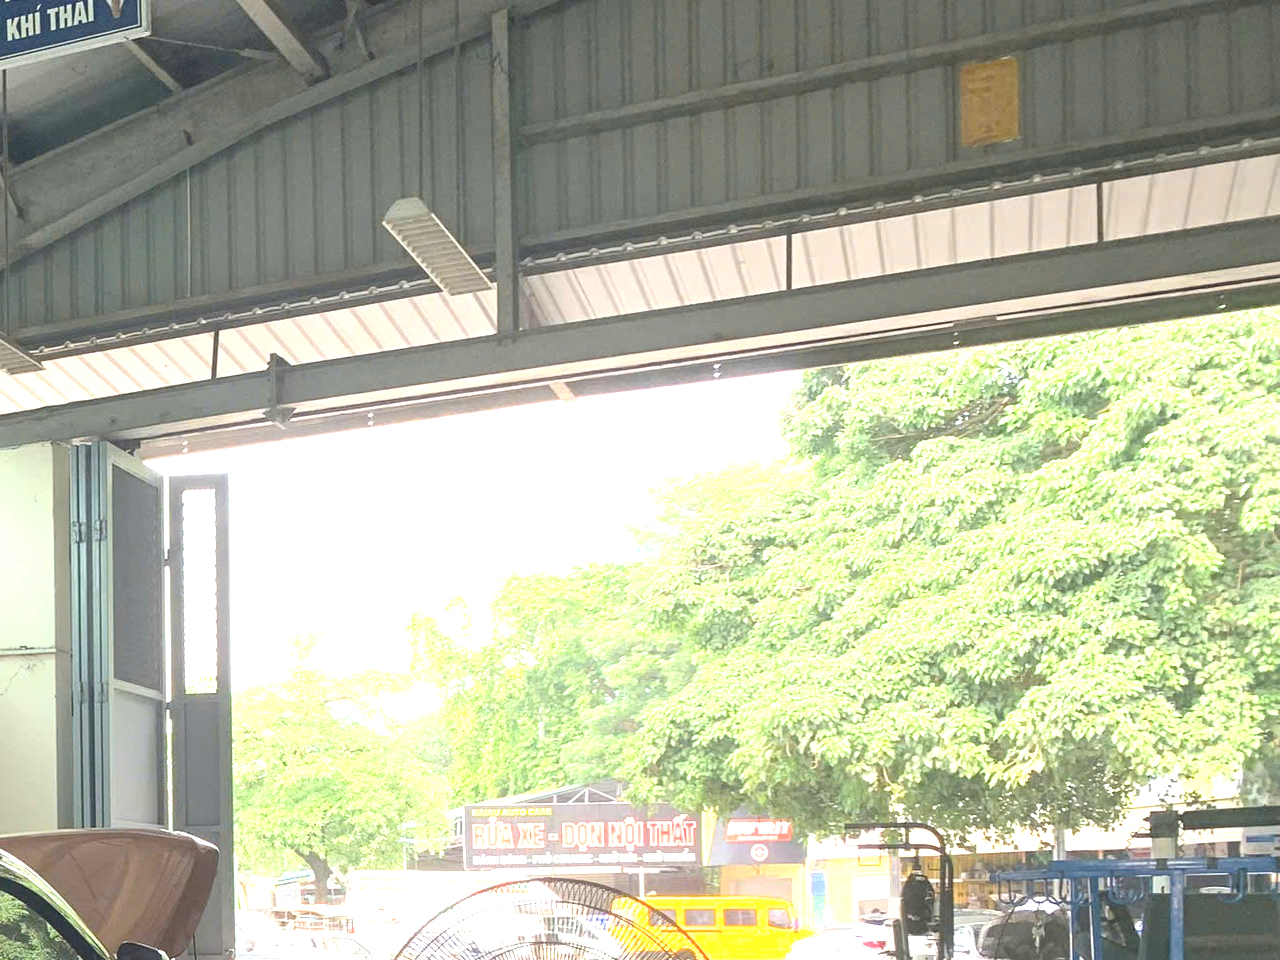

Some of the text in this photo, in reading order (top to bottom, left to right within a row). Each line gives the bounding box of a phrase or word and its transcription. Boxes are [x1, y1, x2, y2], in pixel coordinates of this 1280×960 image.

[6, 4, 41, 42] KHÍ
[472, 816, 515, 850] RỬA
[516, 822, 546, 849] XE
[561, 821, 604, 852] DỌN
[607, 816, 645, 852] NỘI
[646, 814, 697, 847] THẤT
